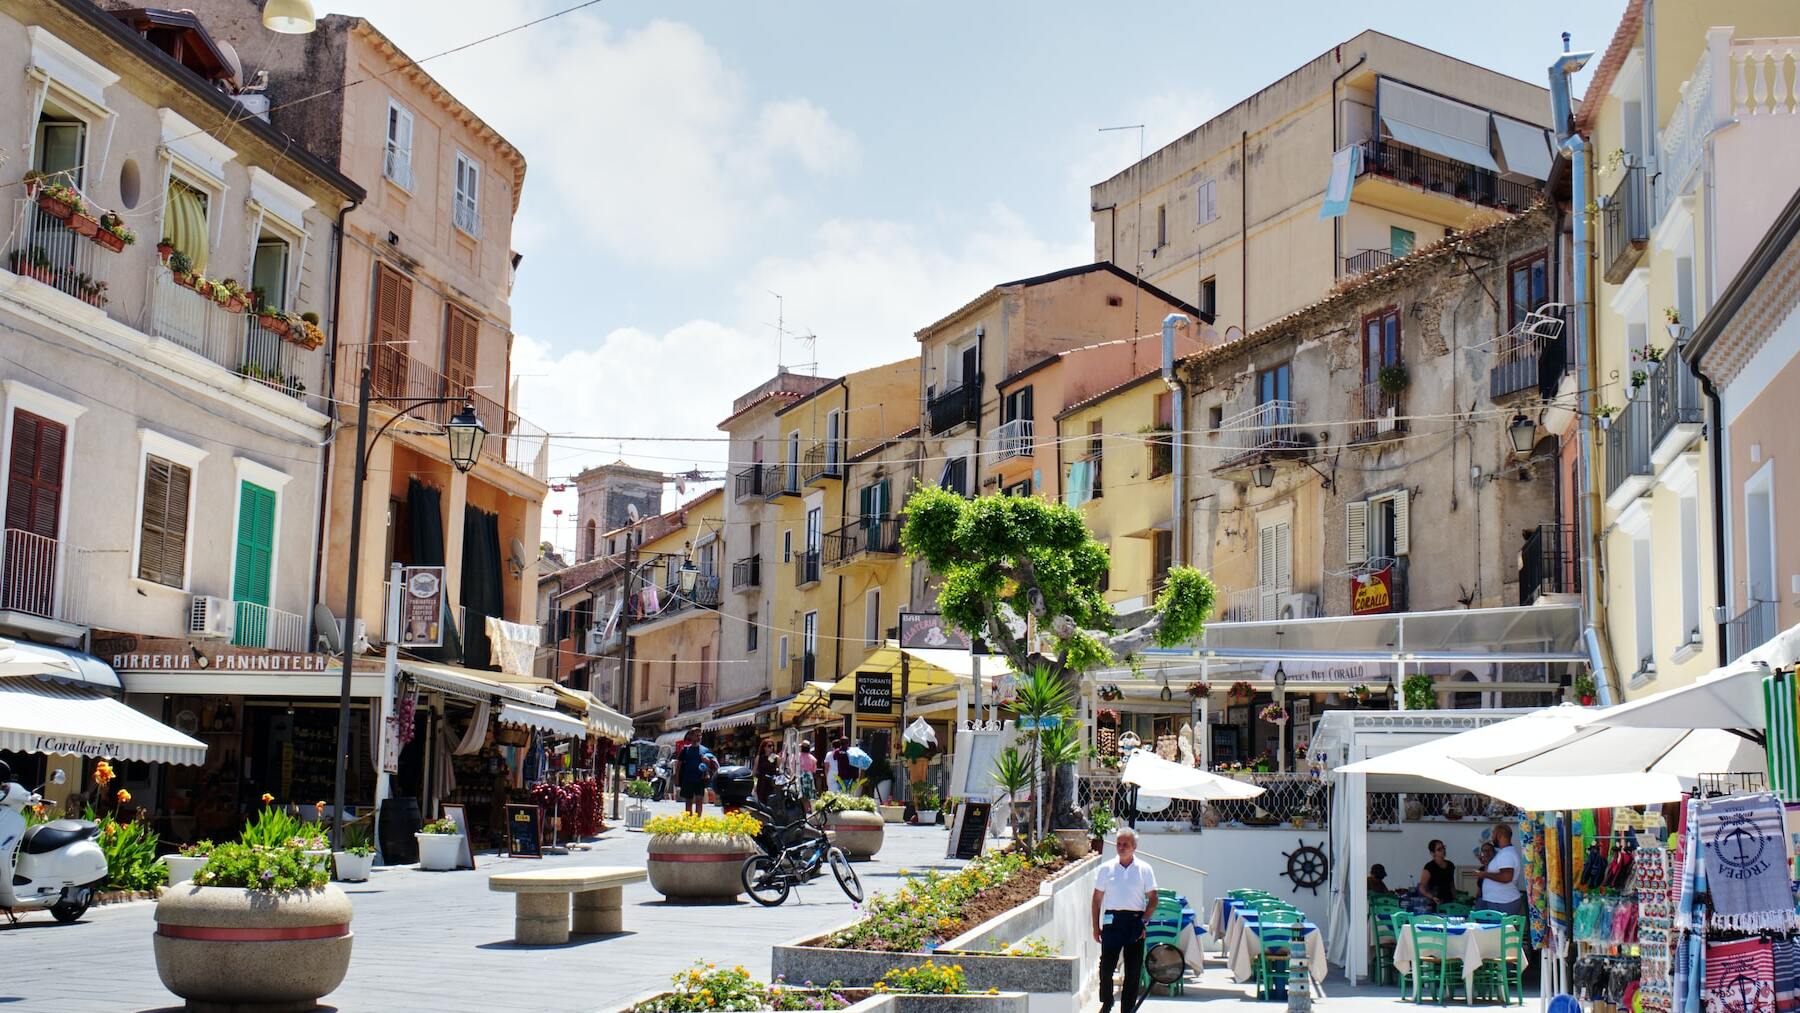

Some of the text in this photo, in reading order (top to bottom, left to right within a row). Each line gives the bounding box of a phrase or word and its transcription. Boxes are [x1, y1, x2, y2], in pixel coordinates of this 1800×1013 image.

[1355, 593, 1387, 610] CORALLO
[902, 614, 921, 622] BAR
[112, 654, 325, 670] BIRRERIA PANINOTECA
[858, 684, 890, 696] Scacco
[859, 695, 890, 707] Matto
[35, 736, 41, 749] I
[44, 737, 103, 755] Corallari
[1718, 860, 1771, 880] TROPEA
